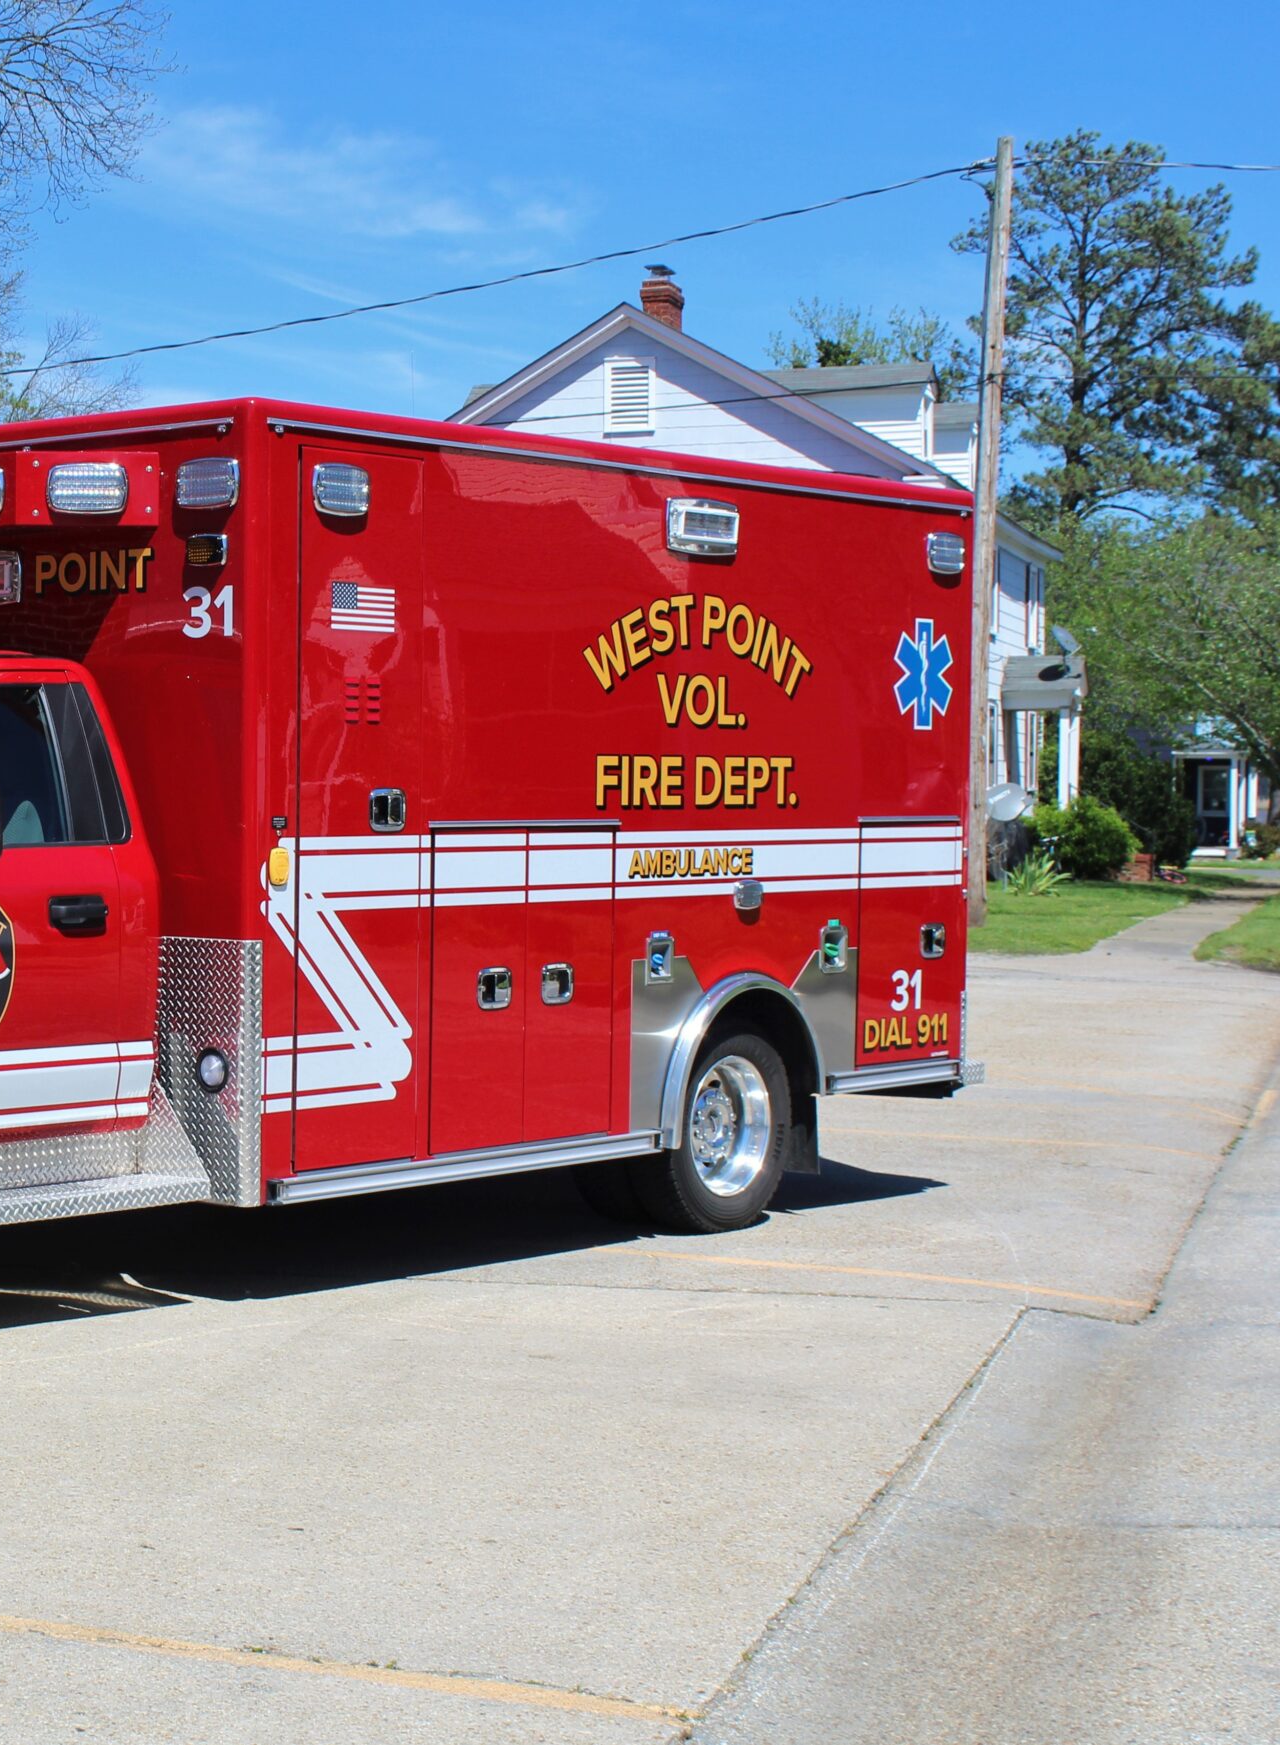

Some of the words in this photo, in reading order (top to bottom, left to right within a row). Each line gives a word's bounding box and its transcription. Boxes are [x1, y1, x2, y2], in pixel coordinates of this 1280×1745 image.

[35, 547, 153, 594] POINT
[182, 584, 234, 639] 31
[582, 593, 695, 692] WEST
[701, 594, 812, 697] POINT
[656, 673, 747, 727] VOL.
[595, 755, 683, 807] FIRE
[694, 755, 798, 807] DEPT.
[628, 848, 754, 878] AMBULANCE
[890, 968, 923, 1012] 31
[863, 1016, 912, 1050] DIAL
[917, 1012, 948, 1045] 911
